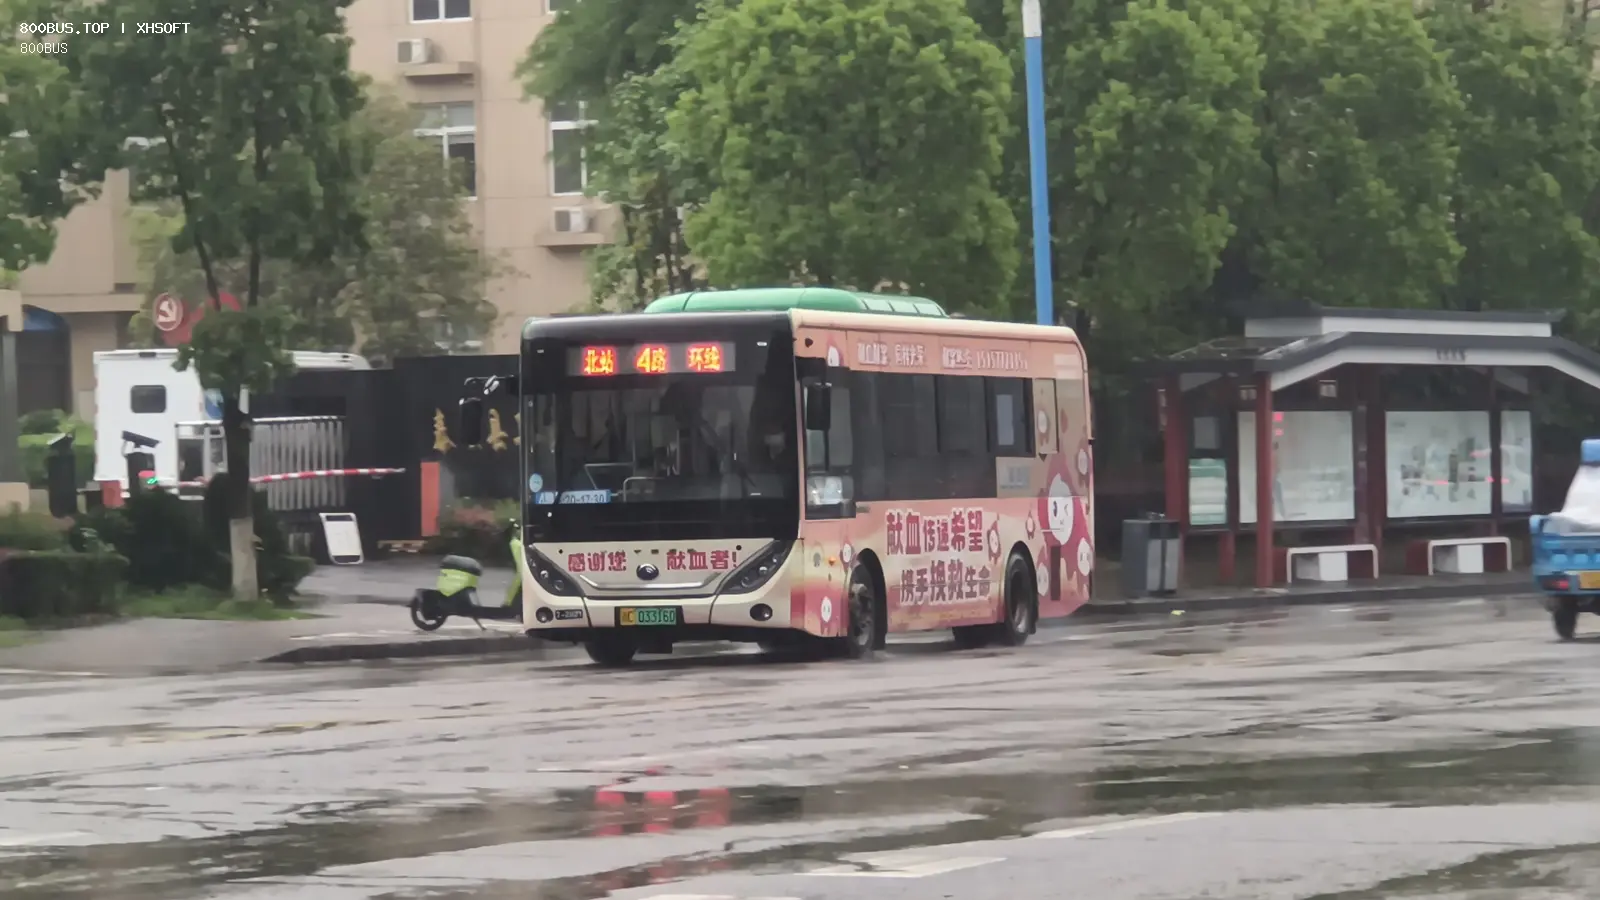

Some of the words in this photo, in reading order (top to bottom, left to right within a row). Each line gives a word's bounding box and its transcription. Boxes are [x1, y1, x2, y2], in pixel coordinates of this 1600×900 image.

[583, 347, 615, 374] 北站
[636, 346, 667, 373] 4路
[687, 345, 722, 371] 环线
[886, 510, 984, 555] 献血传递希望
[567, 551, 627, 572] 感谢您
[666, 549, 739, 571] 献血者!
[901, 559, 991, 603] 携手挽救生命
